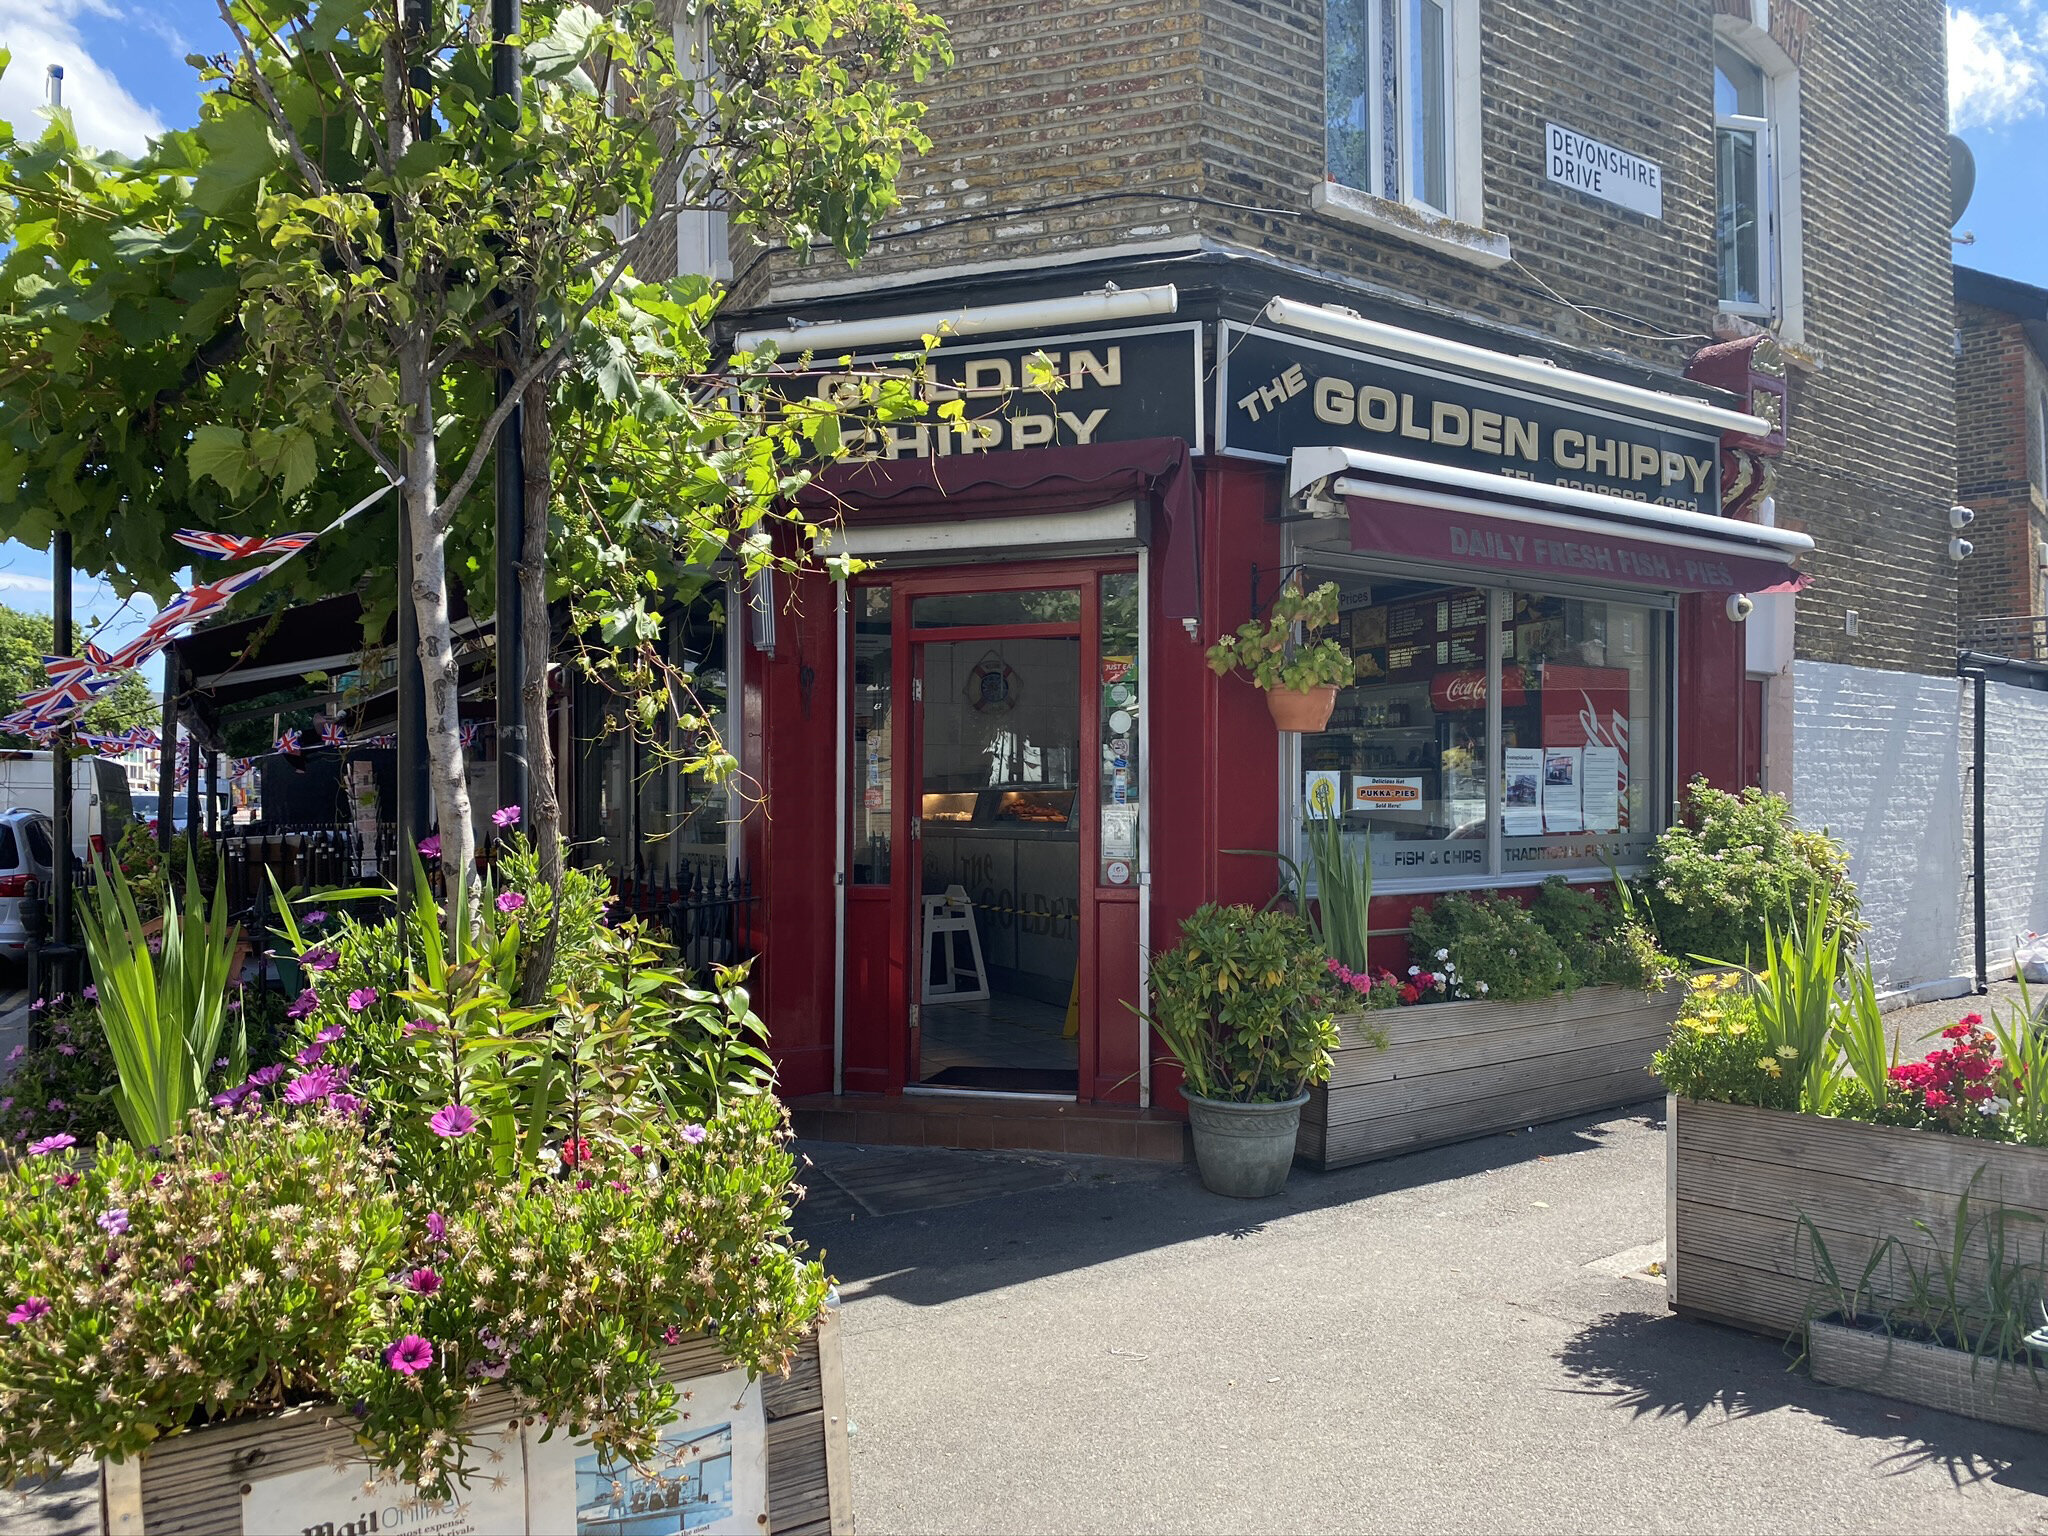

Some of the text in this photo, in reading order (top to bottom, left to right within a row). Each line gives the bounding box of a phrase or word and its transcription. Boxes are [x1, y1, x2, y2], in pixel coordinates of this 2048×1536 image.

[1553, 129, 1656, 188] DEVONSHIRE
[1553, 156, 1602, 192] DRIVE
[836, 408, 1110, 464] CHIPPY
[1237, 363, 1712, 493] THE GOLDEN CHIPPY
[1449, 526, 1525, 562] DAILY
[1533, 538, 1615, 571] FRESH
[1617, 549, 1671, 579] FISH
[1684, 559, 1734, 586] PIES
[1340, 591, 1369, 607] Prices
[1105, 663, 1135, 671] JUST EAT
[1446, 676, 1487, 702] Coca-Co
[1394, 851, 1425, 866] FISH
[1443, 849, 1482, 865] CHIPS
[1505, 846, 1582, 862] TRADITIONAL
[424, 1518, 466, 1534] expense
